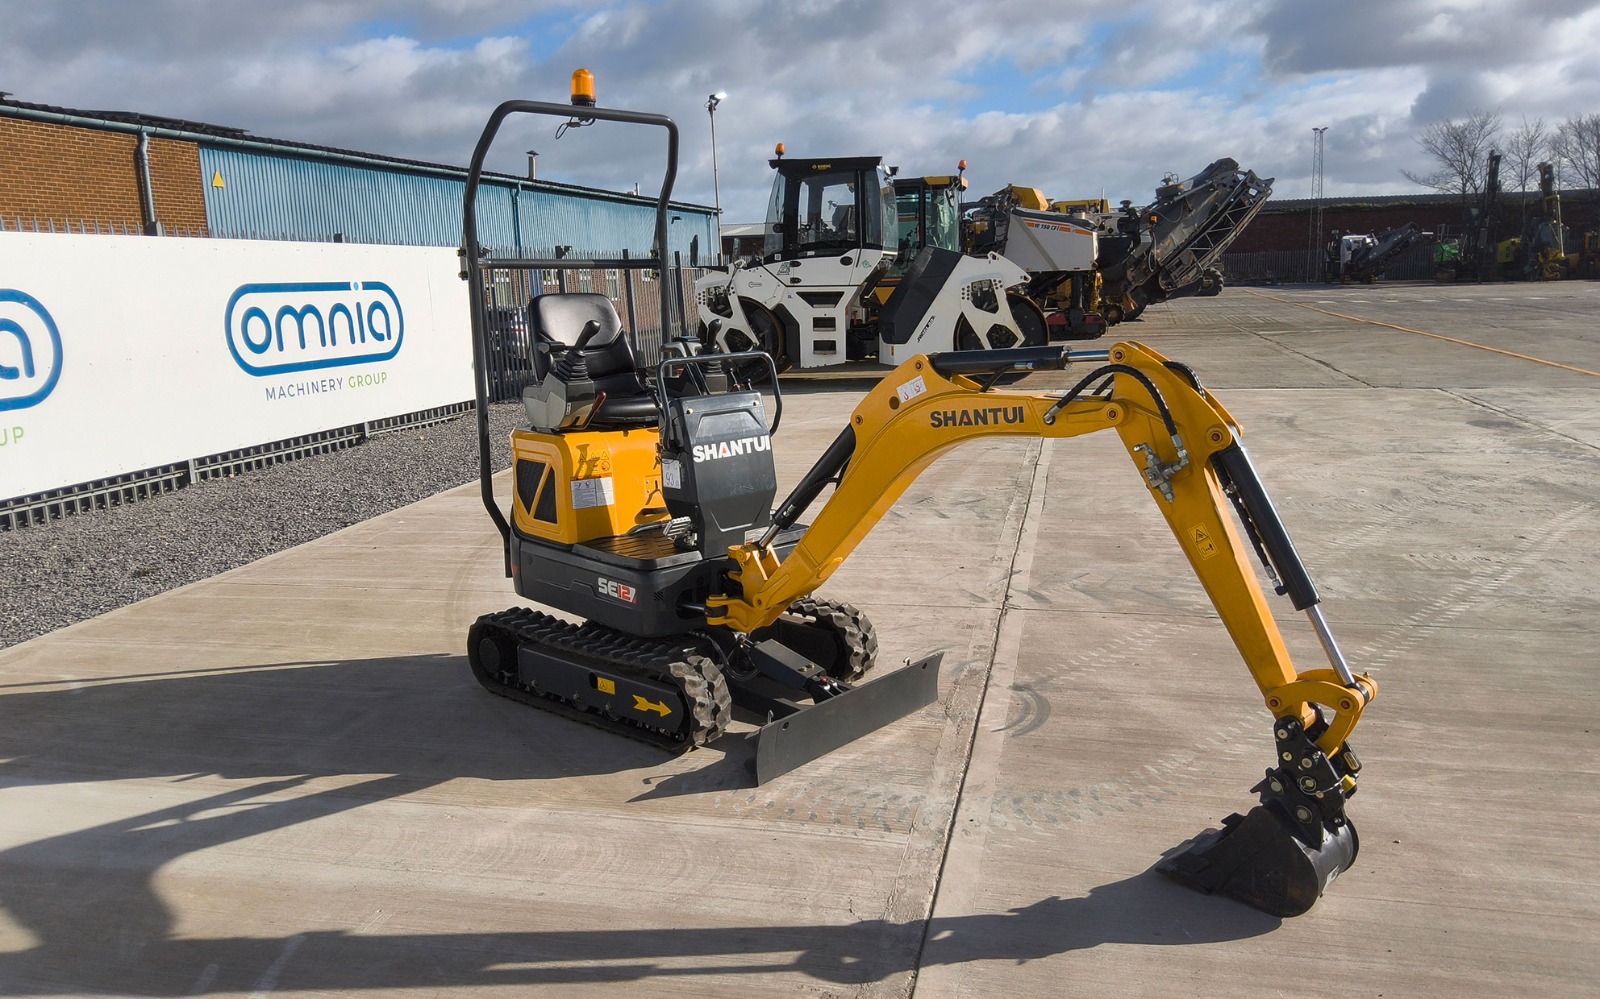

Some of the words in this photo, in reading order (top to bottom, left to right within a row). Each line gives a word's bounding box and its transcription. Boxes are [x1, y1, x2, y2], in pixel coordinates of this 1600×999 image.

[241, 281, 392, 354] omnia
[265, 377, 343, 401] MACHINERY
[348, 371, 388, 389] GROUP
[930, 406, 1025, 428] SHANTUI
[692, 435, 771, 463] SHANTUI
[597, 577, 635, 603] SE12
